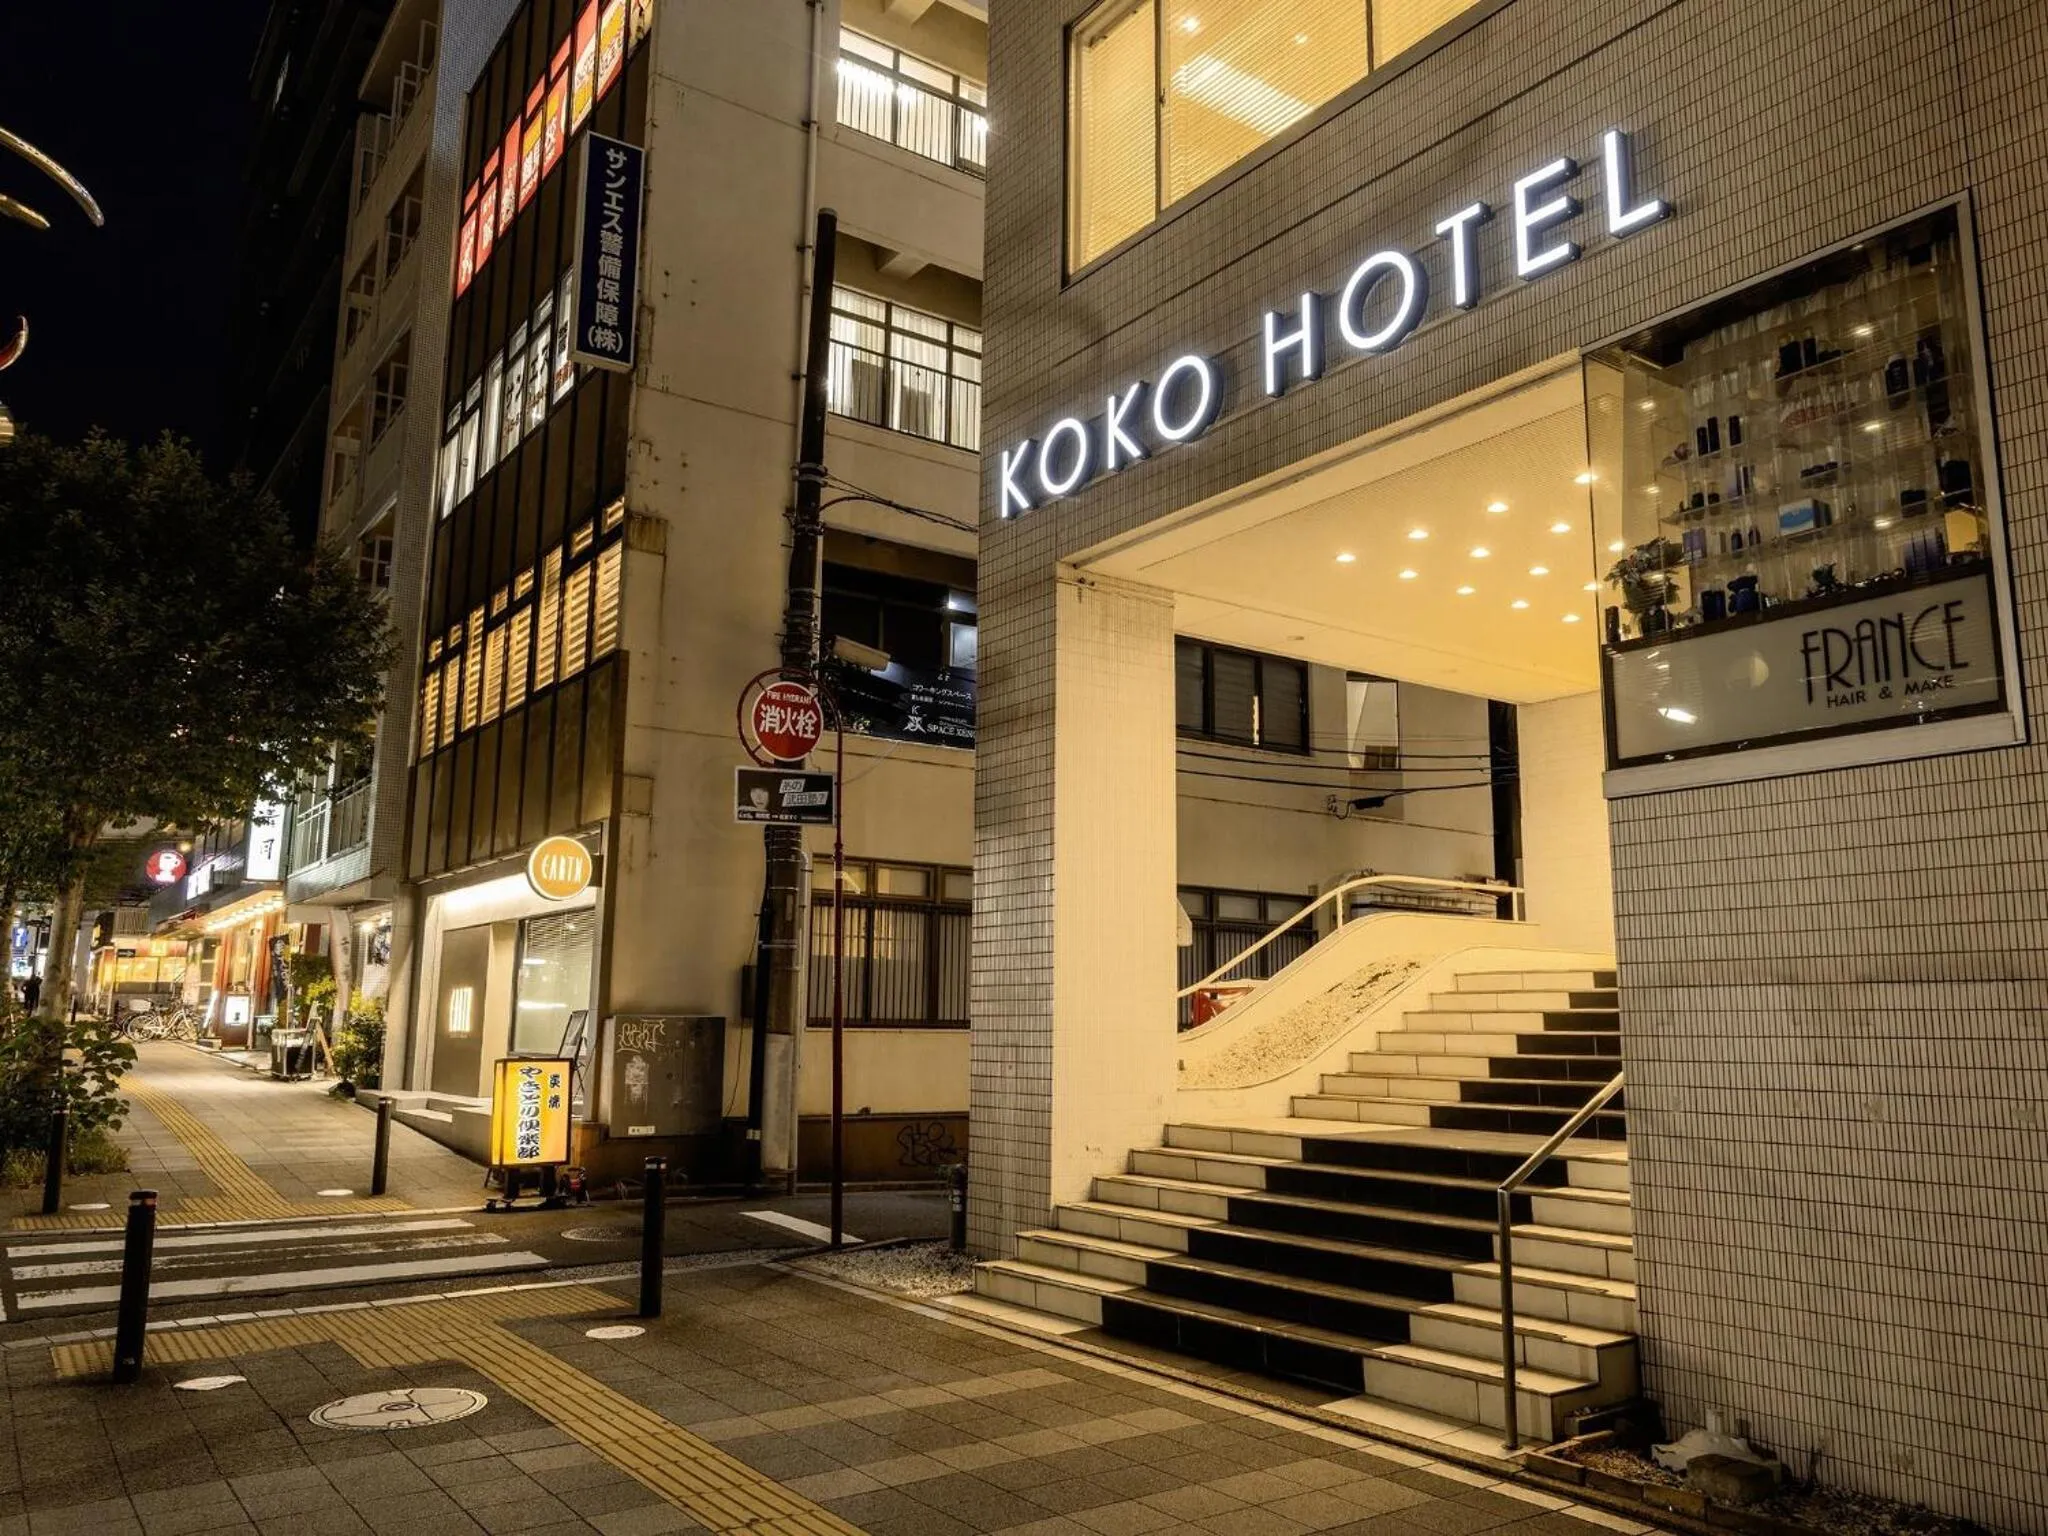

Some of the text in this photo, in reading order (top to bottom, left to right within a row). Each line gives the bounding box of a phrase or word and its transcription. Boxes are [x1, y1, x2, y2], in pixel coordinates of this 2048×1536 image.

[588, 148, 627, 353] サンエス警備保障(株)
[1001, 128, 1669, 519] KOKO HOTEL
[1801, 600, 1969, 704] FRANCE
[767, 690, 812, 704] FIRE HYDRANT
[1827, 674, 1957, 708] HAIR & MAKE
[759, 704, 817, 739] 消火栓
[927, 723, 955, 736] SPACE
[541, 854, 583, 882] EARTH
